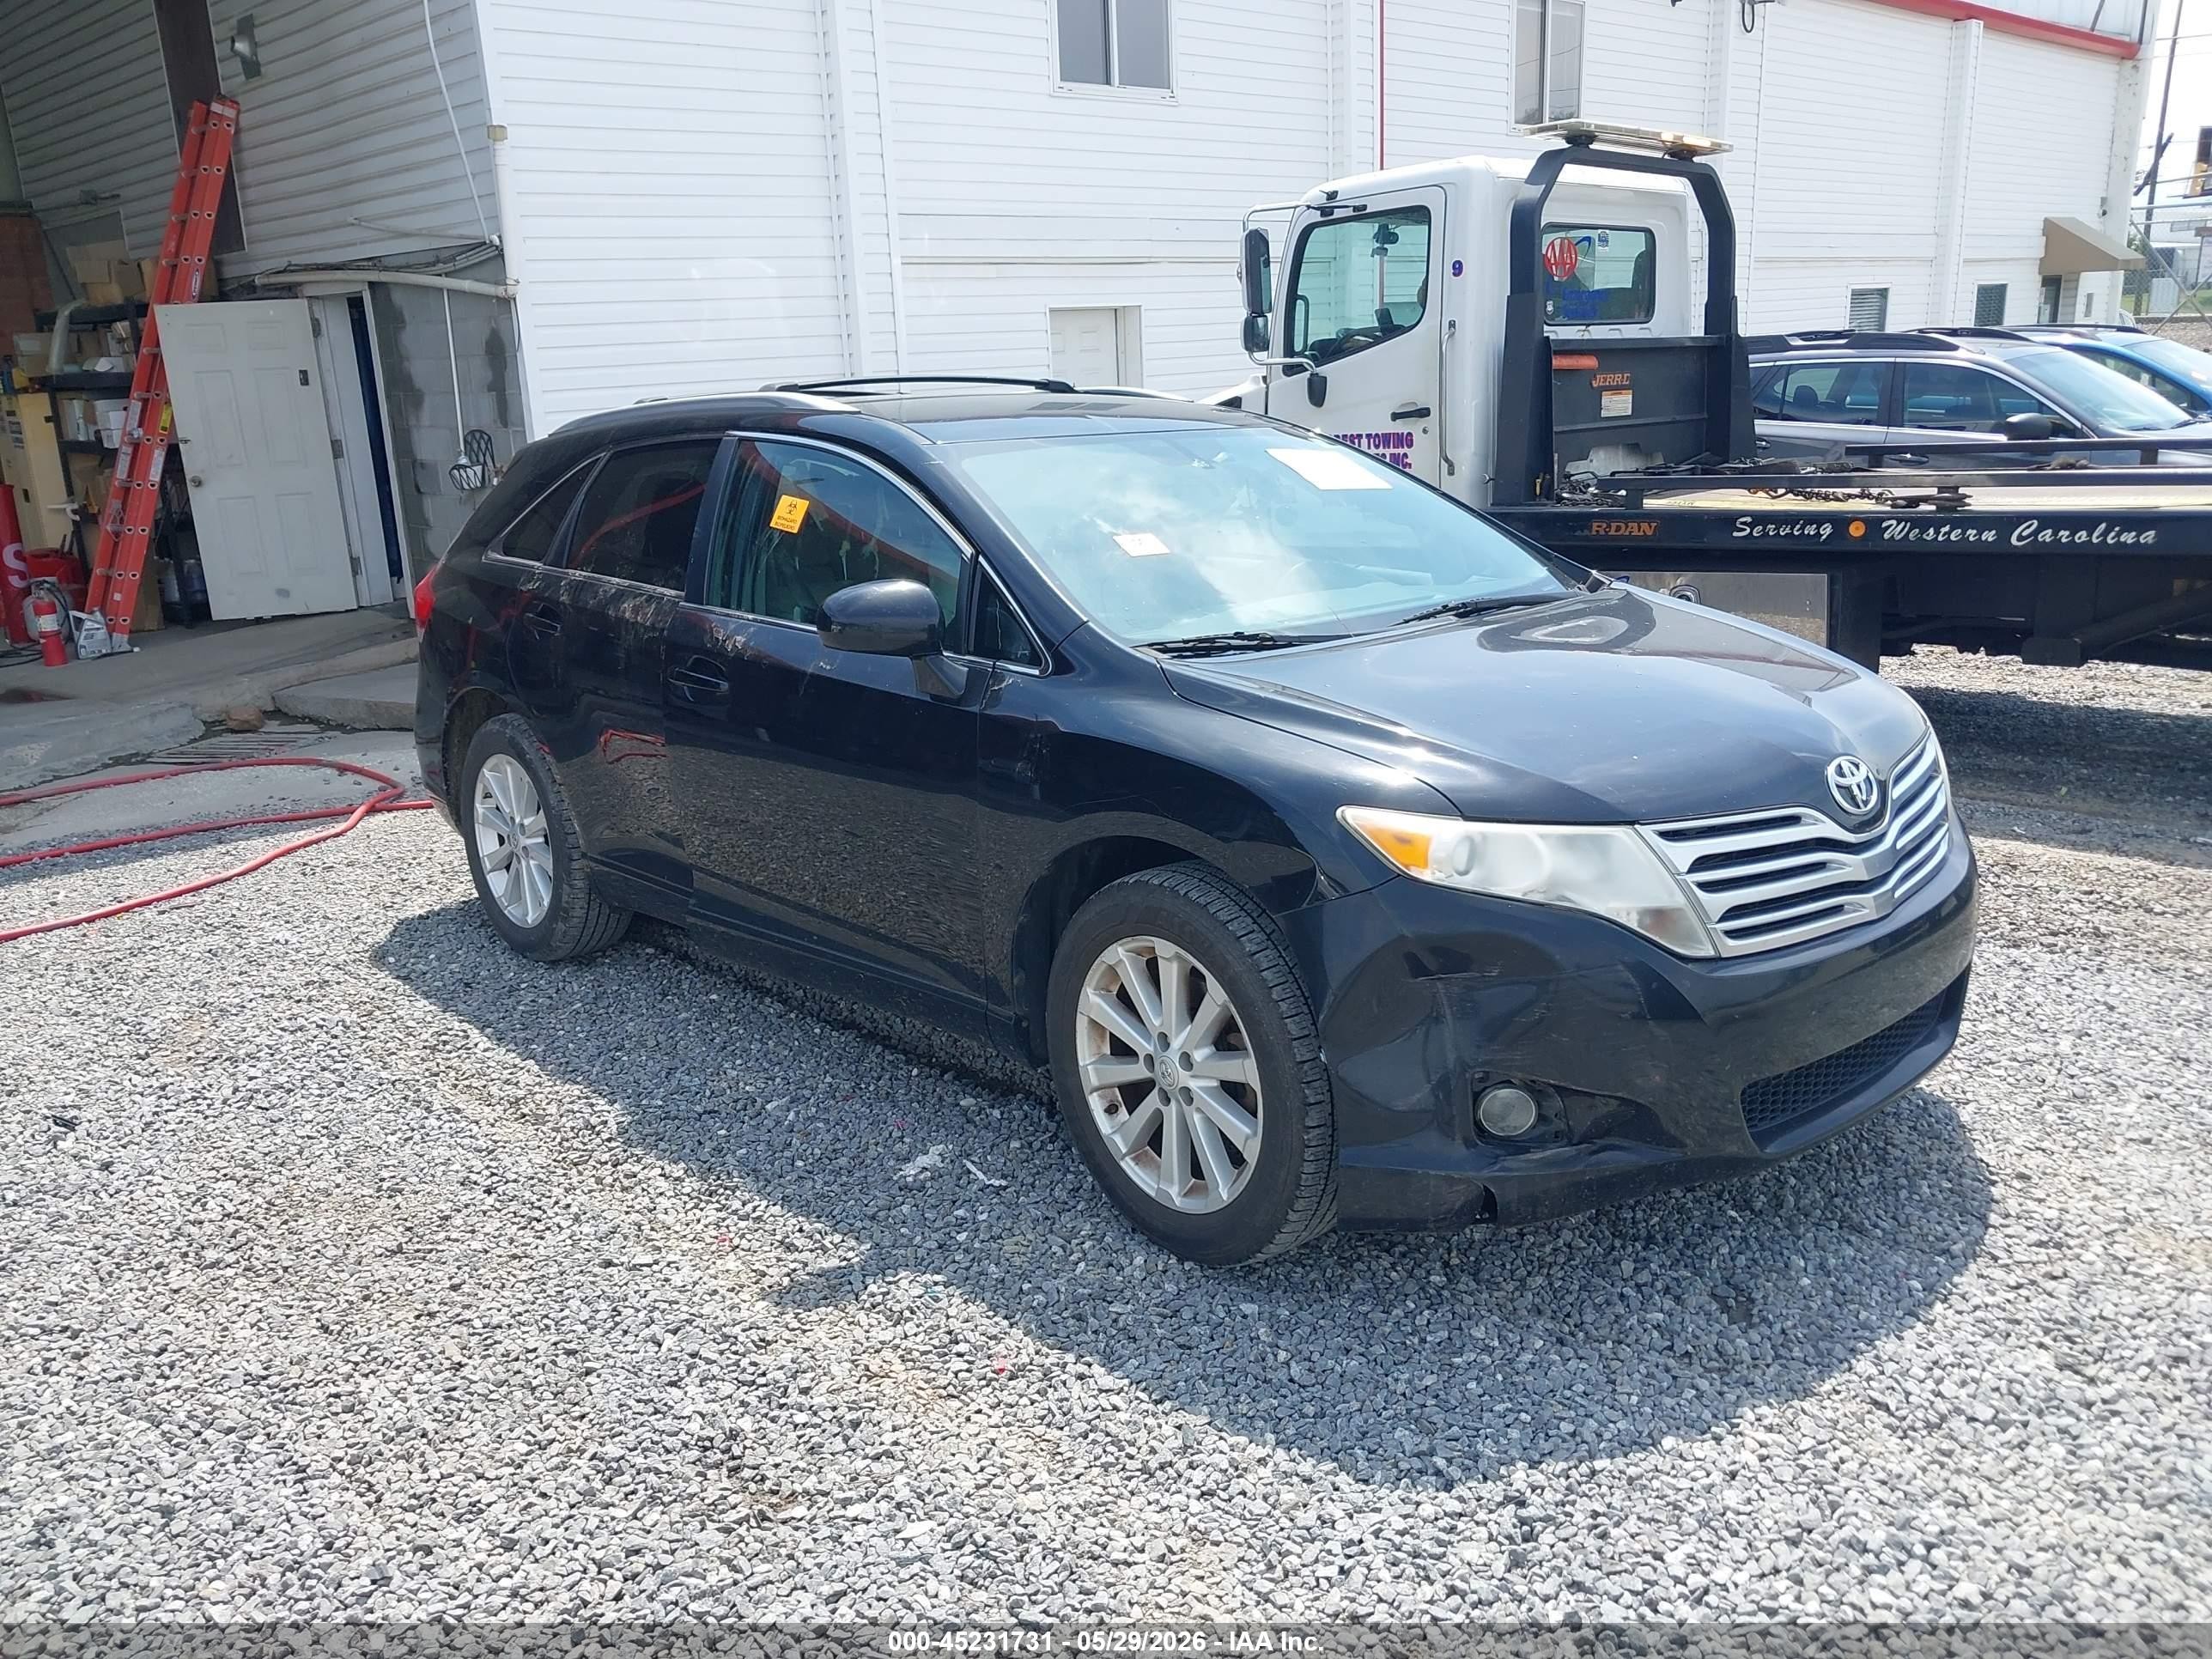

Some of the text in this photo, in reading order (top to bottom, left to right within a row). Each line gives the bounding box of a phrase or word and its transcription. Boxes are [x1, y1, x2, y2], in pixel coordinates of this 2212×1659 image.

[1451, 259, 1464, 277] 9
[1365, 431, 1414, 450] TOWING
[1389, 452, 1413, 469] INC.
[1732, 516, 2160, 547] Serving Western Carolina
